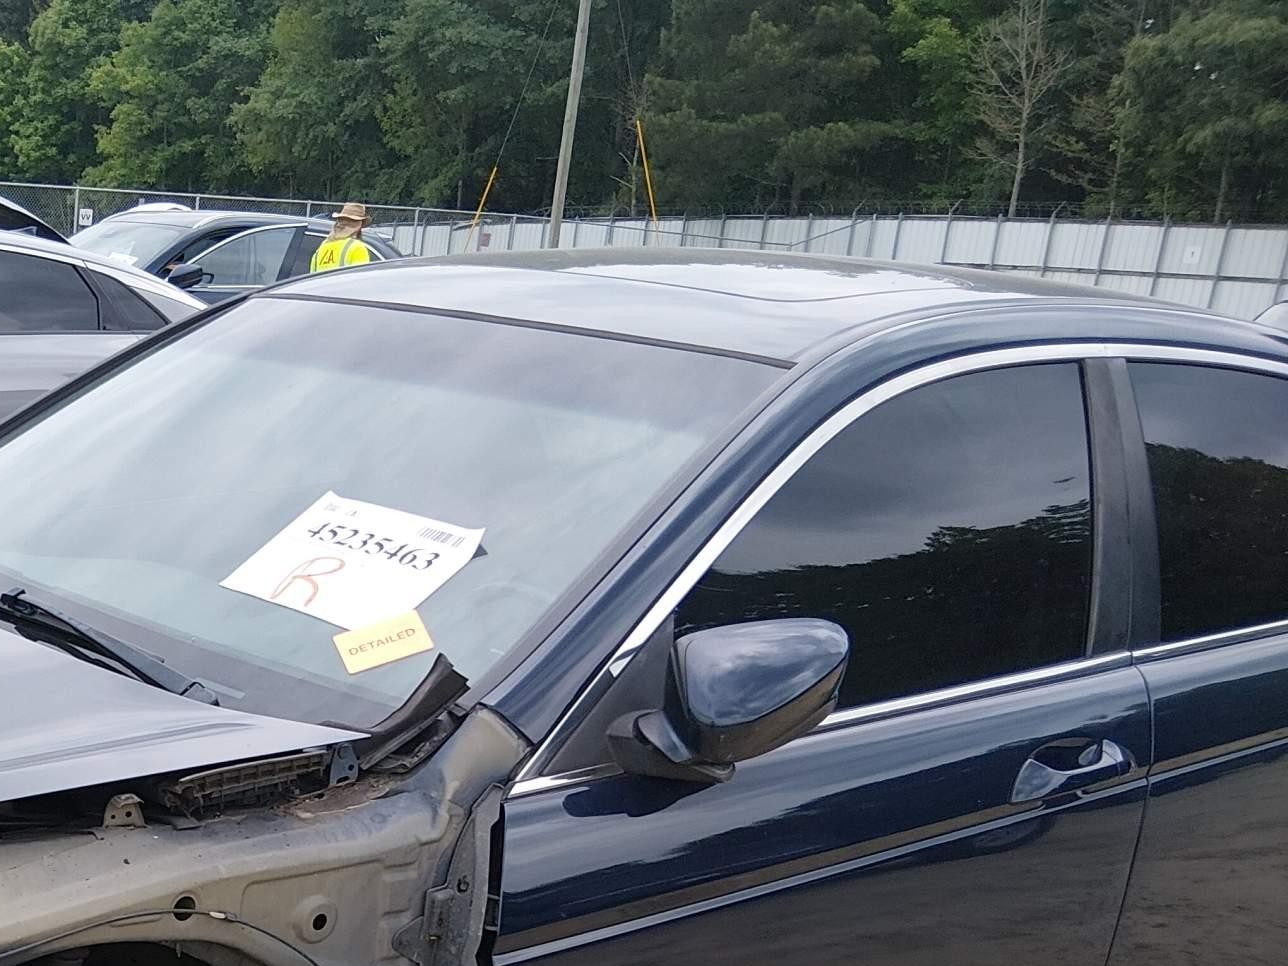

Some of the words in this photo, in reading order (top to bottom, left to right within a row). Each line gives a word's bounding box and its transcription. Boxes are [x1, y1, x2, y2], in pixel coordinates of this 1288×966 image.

[307, 522, 441, 571] 45235463
[269, 556, 347, 608] R
[348, 627, 417, 656] DETAILED
